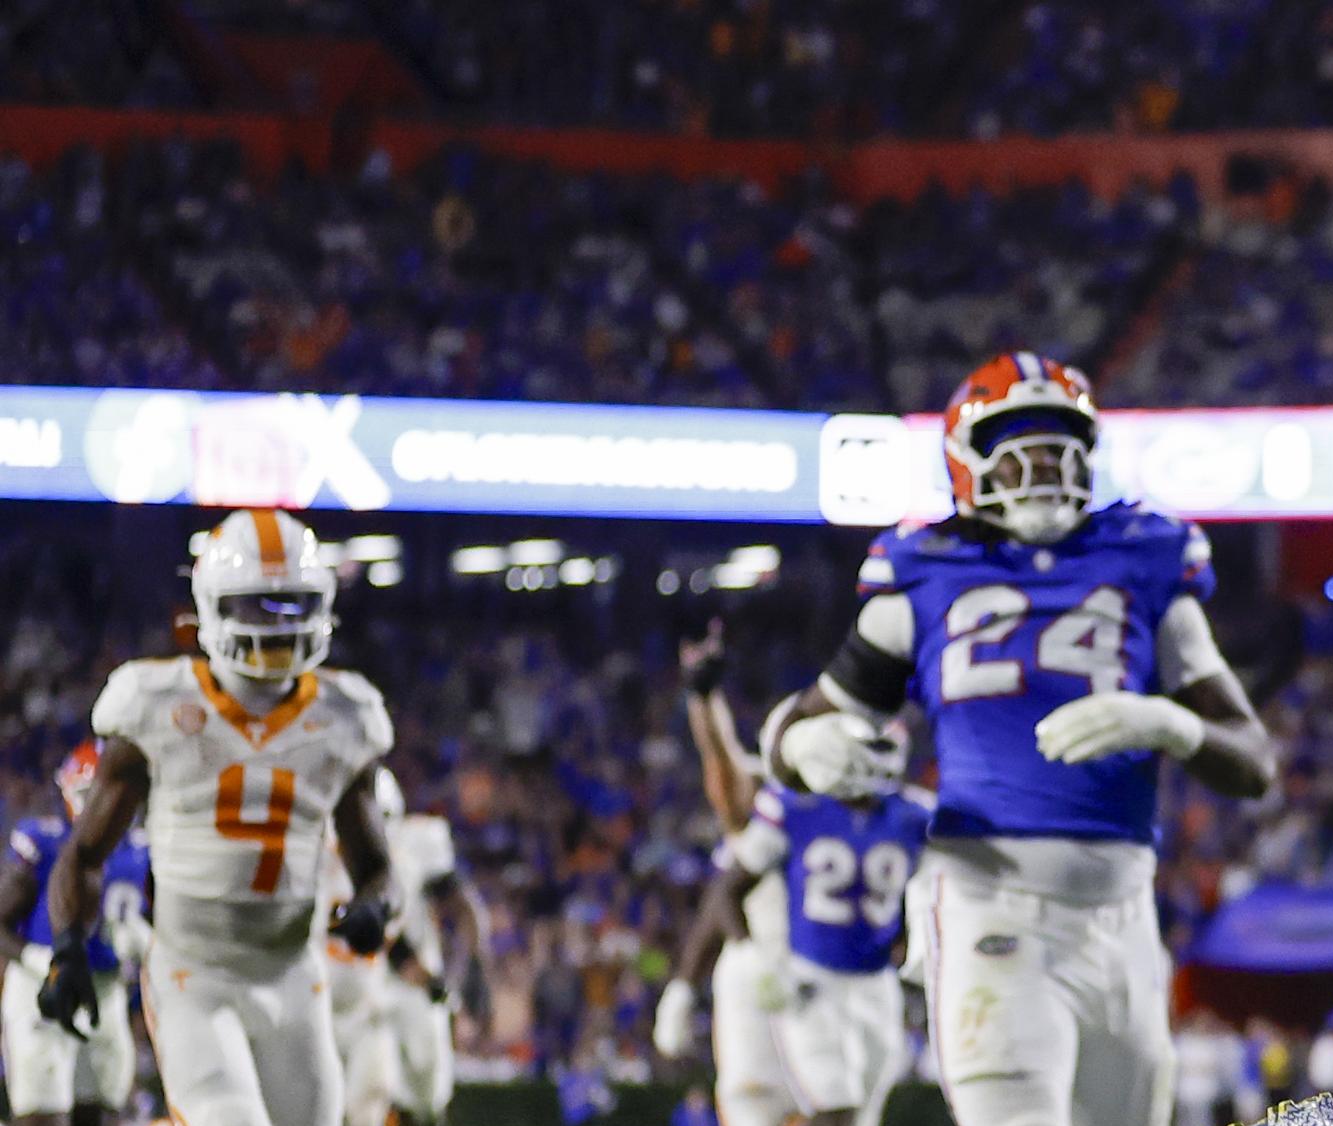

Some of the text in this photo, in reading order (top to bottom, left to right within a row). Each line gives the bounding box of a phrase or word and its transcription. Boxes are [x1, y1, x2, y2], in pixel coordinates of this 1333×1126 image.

[939, 583, 1133, 704] 24
[215, 763, 296, 895] 4
[803, 836, 909, 927] 29
